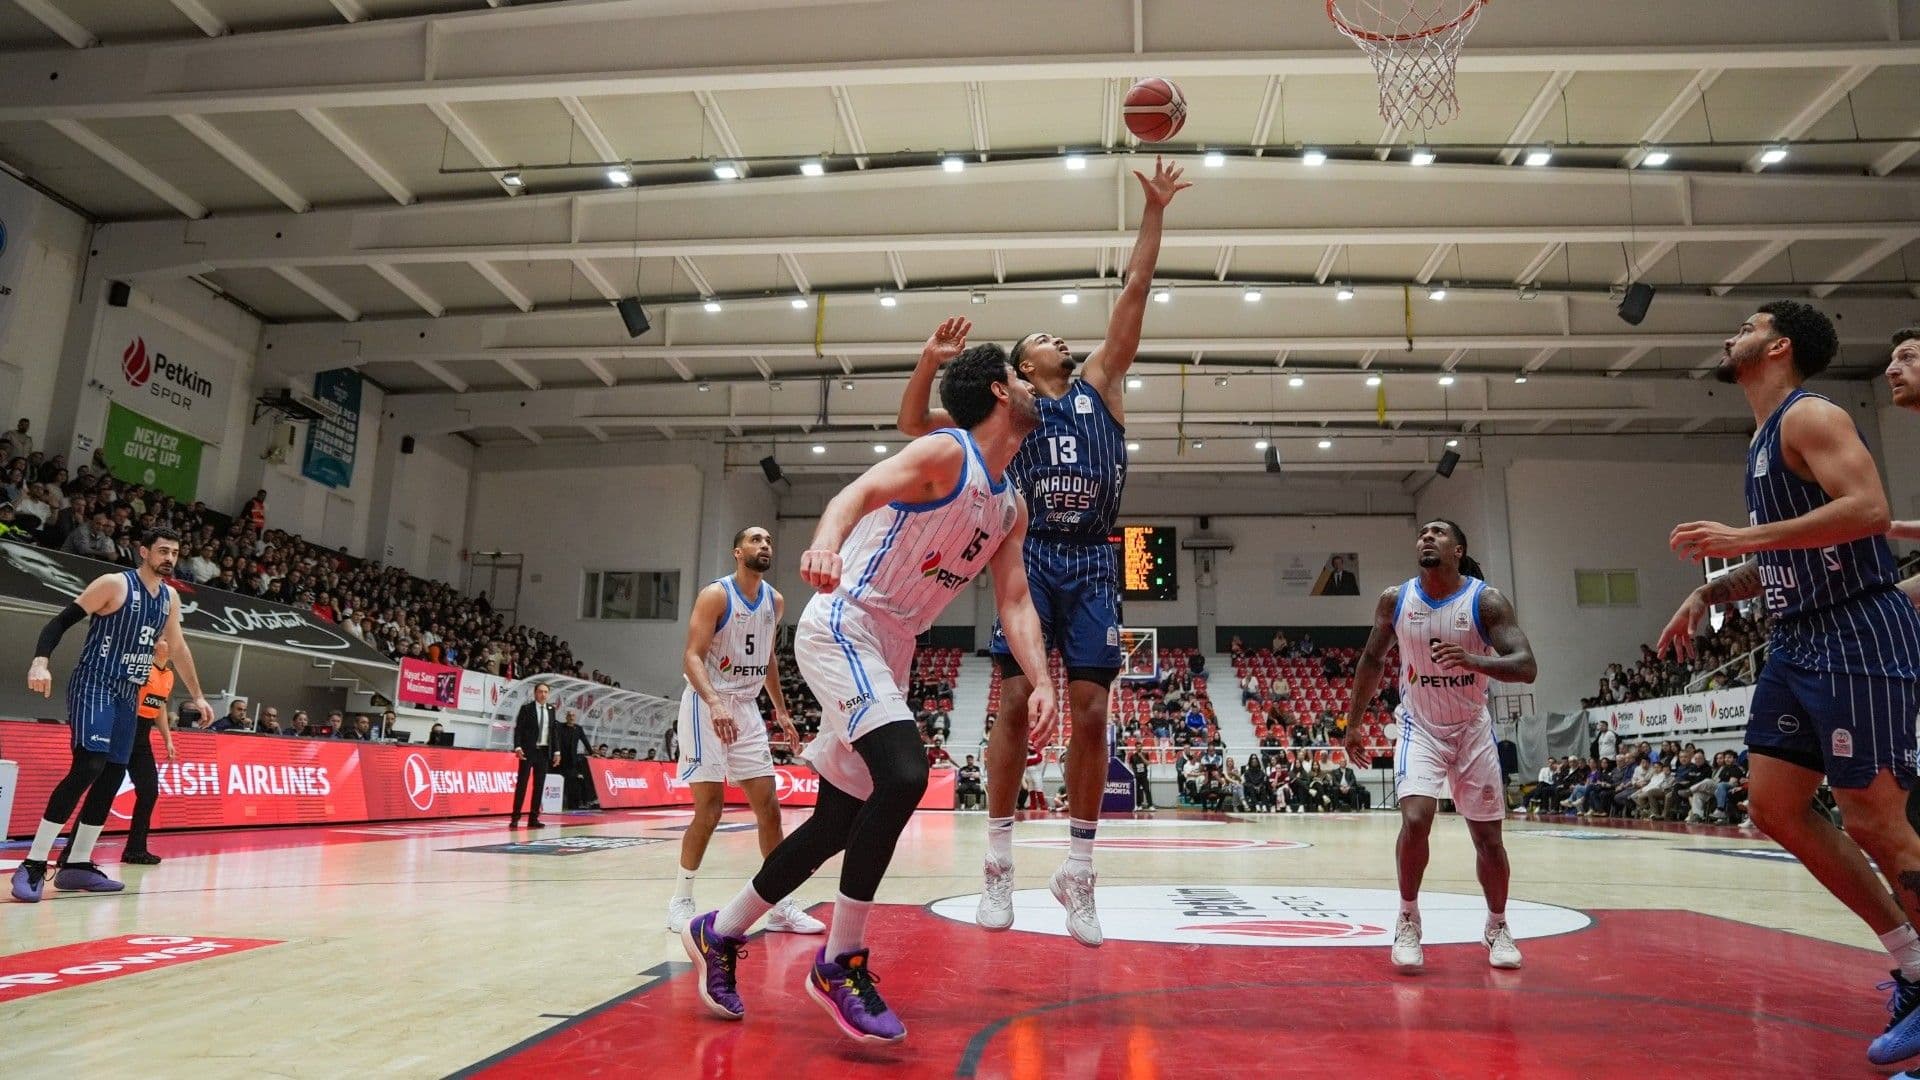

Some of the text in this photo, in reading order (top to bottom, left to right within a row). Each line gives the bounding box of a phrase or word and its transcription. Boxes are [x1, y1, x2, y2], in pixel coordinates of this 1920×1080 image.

[153, 352, 213, 399] Petkim
[150, 382, 192, 411] SPOR
[134, 426, 180, 451] NEVER
[123, 441, 181, 469] GIVE UP!
[1047, 435, 1078, 466] 13
[1034, 476, 1099, 499] ANADOLU
[1044, 492, 1090, 509] EFES
[961, 527, 990, 562] 15
[935, 568, 970, 590] PETK
[1758, 565, 1796, 589] DOLU
[744, 633, 755, 656] 5
[1645, 713, 1668, 727] SOCAR
[1682, 703, 1703, 715] Petkim
[1718, 705, 1746, 721] SOCAR
[227, 763, 331, 796] AIRLINES
[793, 778, 820, 793] KIS
